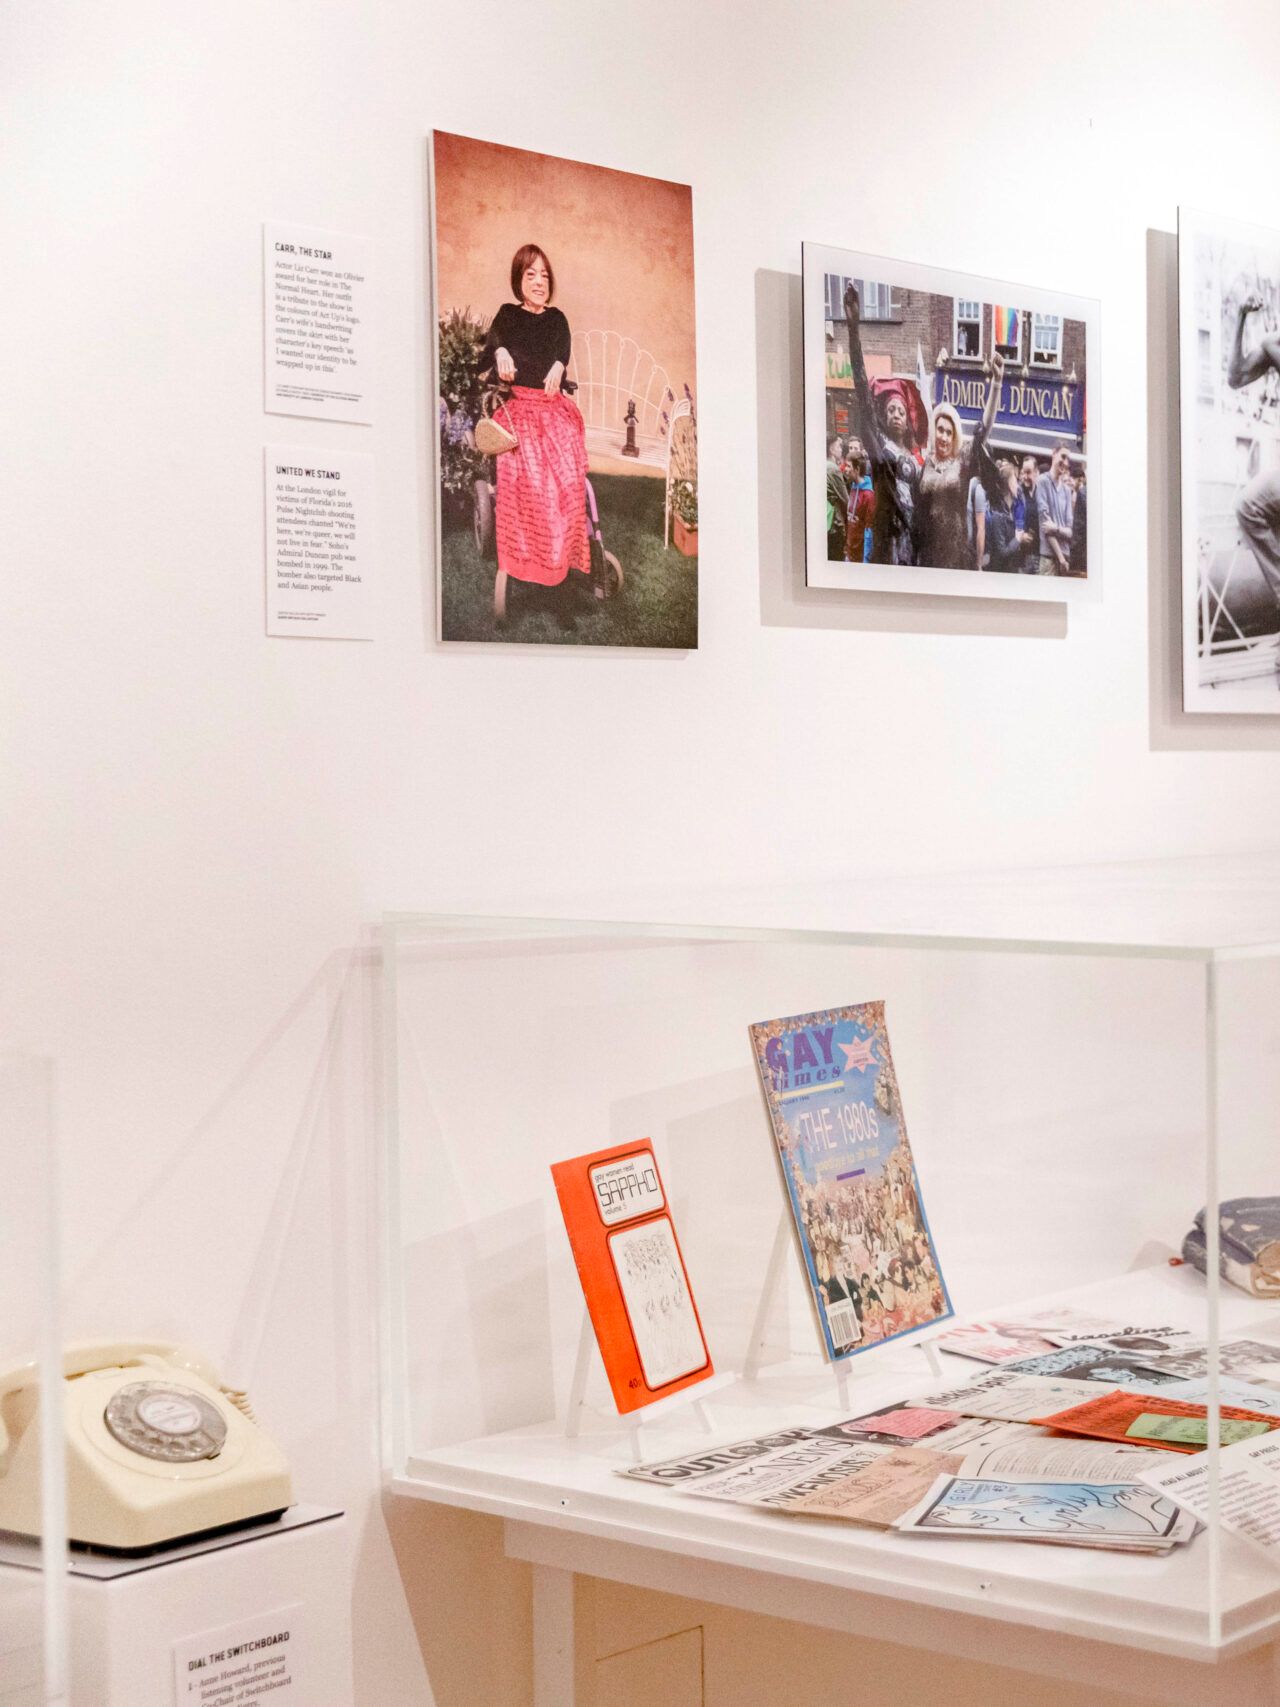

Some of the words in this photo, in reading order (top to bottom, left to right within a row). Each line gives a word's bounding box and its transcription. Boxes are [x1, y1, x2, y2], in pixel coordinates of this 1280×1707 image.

[275, 242, 298, 256] CARR,
[299, 246, 313, 257] THE
[313, 249, 333, 260] STAR
[305, 265, 319, 274] Carr
[275, 281, 299, 292] Normal
[340, 282, 352, 290] The
[942, 375, 1006, 412] ADMIRL
[1009, 384, 1073, 421] DUNCAN
[276, 465, 304, 477] UNITED
[304, 468, 316, 478] WE
[316, 470, 341, 480] STAND
[297, 485, 322, 495] London
[338, 489, 347, 497] for
[276, 505, 293, 514] Pulse
[296, 506, 326, 516] Nightclub
[277, 548, 304, 557] Admiral
[305, 550, 330, 559] Duncan
[277, 558, 304, 568] bombed
[331, 562, 343, 571] The
[278, 581, 290, 589] and
[344, 574, 362, 584] Black
[765, 1026, 834, 1073] GAY
[799, 1107, 838, 1153] THE
[837, 1100, 879, 1145] 1980s
[597, 1168, 658, 1207] SAPPHO
[188, 1657, 206, 1672] DIAL
[209, 1651, 226, 1664] THE
[226, 1631, 290, 1659] SWITCHBOARD
[253, 1655, 286, 1672] previous
[234, 1672, 270, 1688] volunteer
[271, 1664, 286, 1677] and
[245, 1676, 292, 1698] Switchboard
